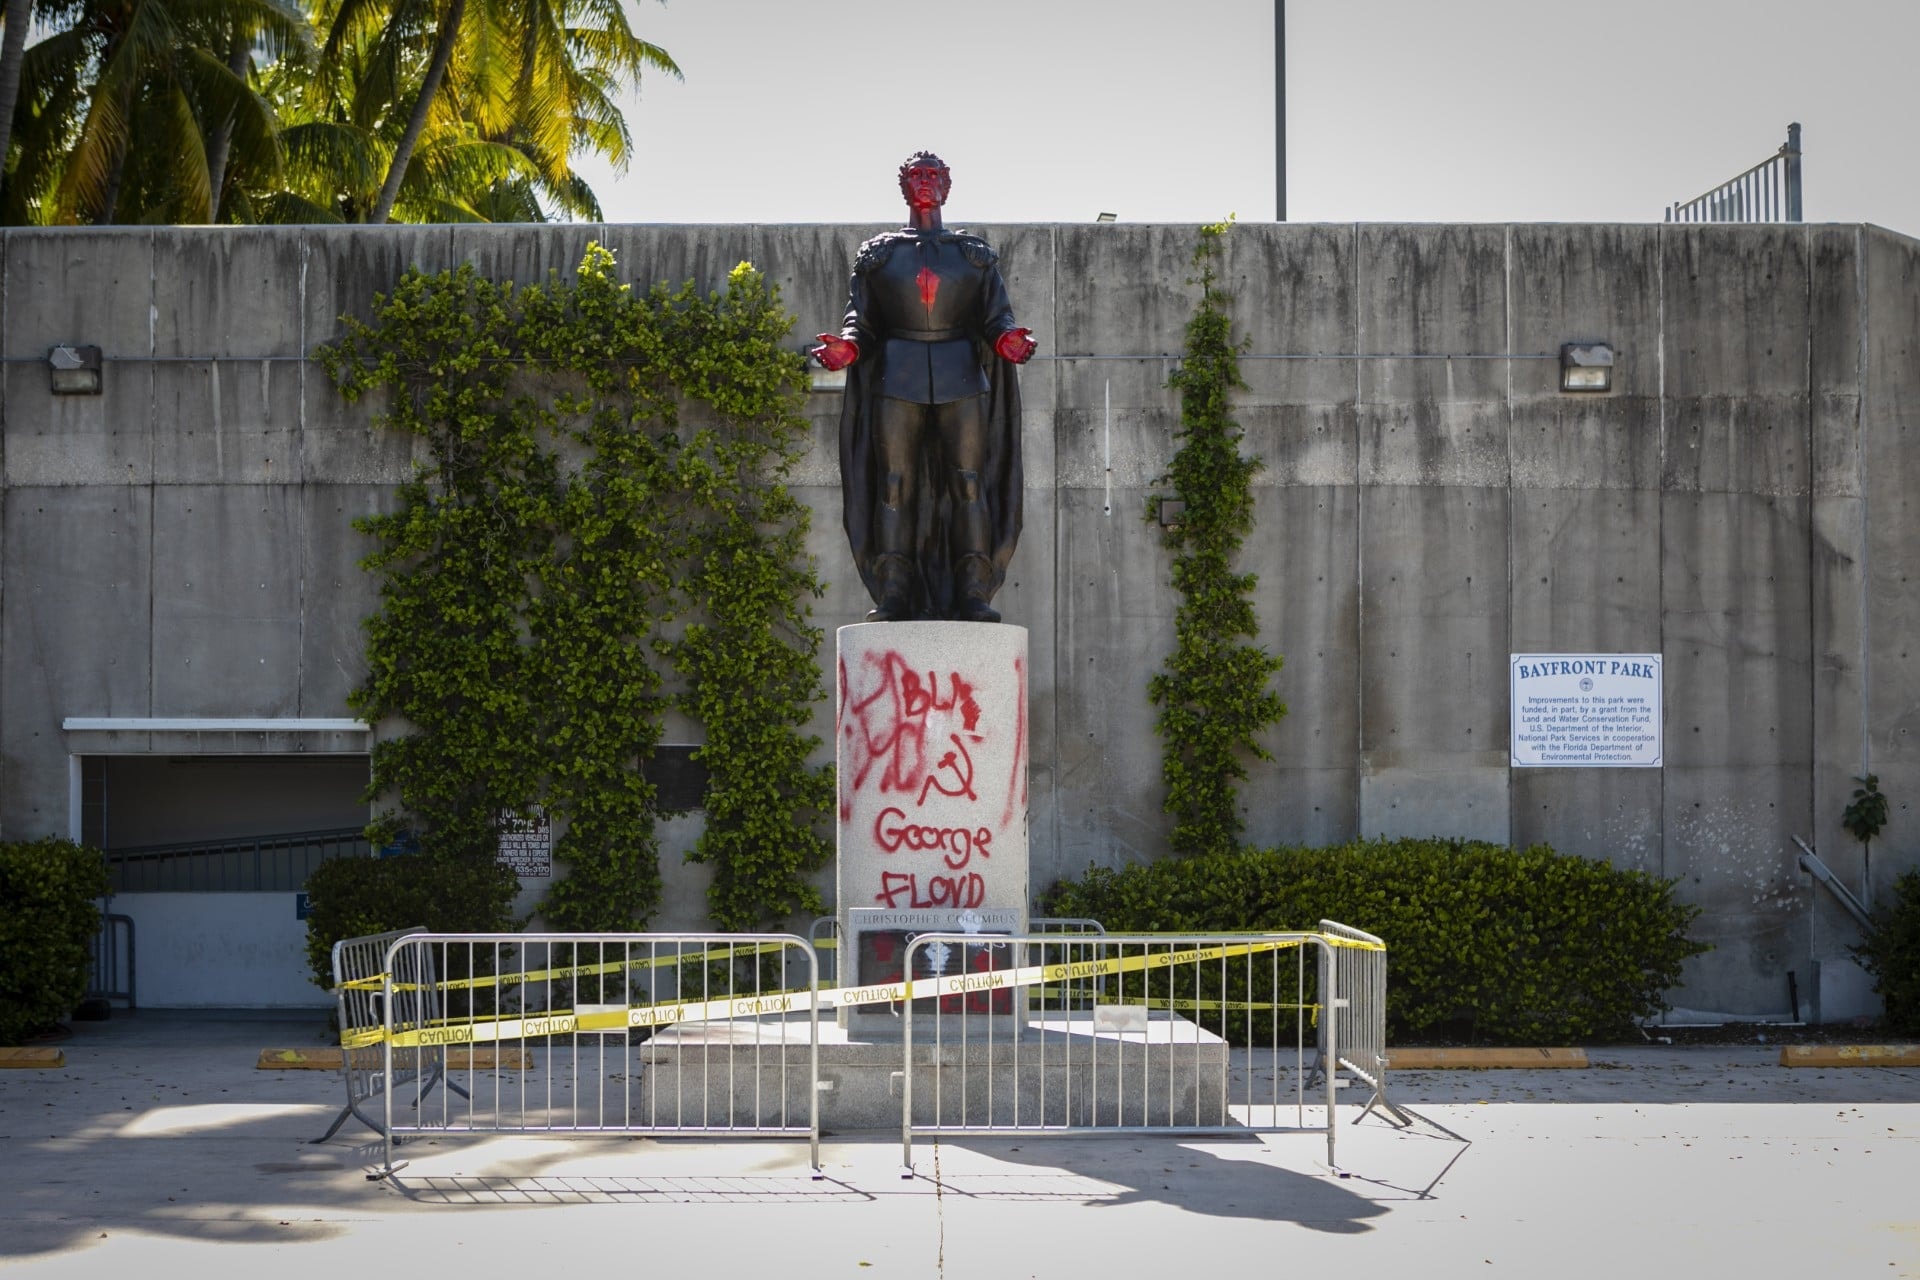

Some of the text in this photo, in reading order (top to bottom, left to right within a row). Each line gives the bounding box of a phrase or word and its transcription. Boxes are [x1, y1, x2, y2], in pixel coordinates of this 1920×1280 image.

[1519, 660, 1654, 679] BAYFRONT PARK
[1528, 696, 1579, 704] Improvements
[1582, 696, 1590, 704] to
[1592, 696, 1606, 704] this
[1608, 696, 1624, 705] park
[1551, 705, 1558, 713] in
[1580, 705, 1588, 714] by
[1599, 706, 1617, 714] grant
[1620, 705, 1637, 713] from
[1640, 705, 1652, 713] the
[1582, 714, 1629, 722] Conservation
[1546, 724, 1589, 732] Department
[1591, 724, 1599, 732] of
[1602, 724, 1614, 732] the
[1518, 733, 1548, 741] National
[1550, 733, 1566, 741] Park
[1569, 733, 1600, 741] Services
[1612, 733, 1655, 742] cooperation
[1531, 743, 1643, 751] with the Florida Department of
[874, 806, 992, 870] George
[876, 871, 985, 909] FLOYD
[854, 913, 940, 925] CHRISTOPHER
